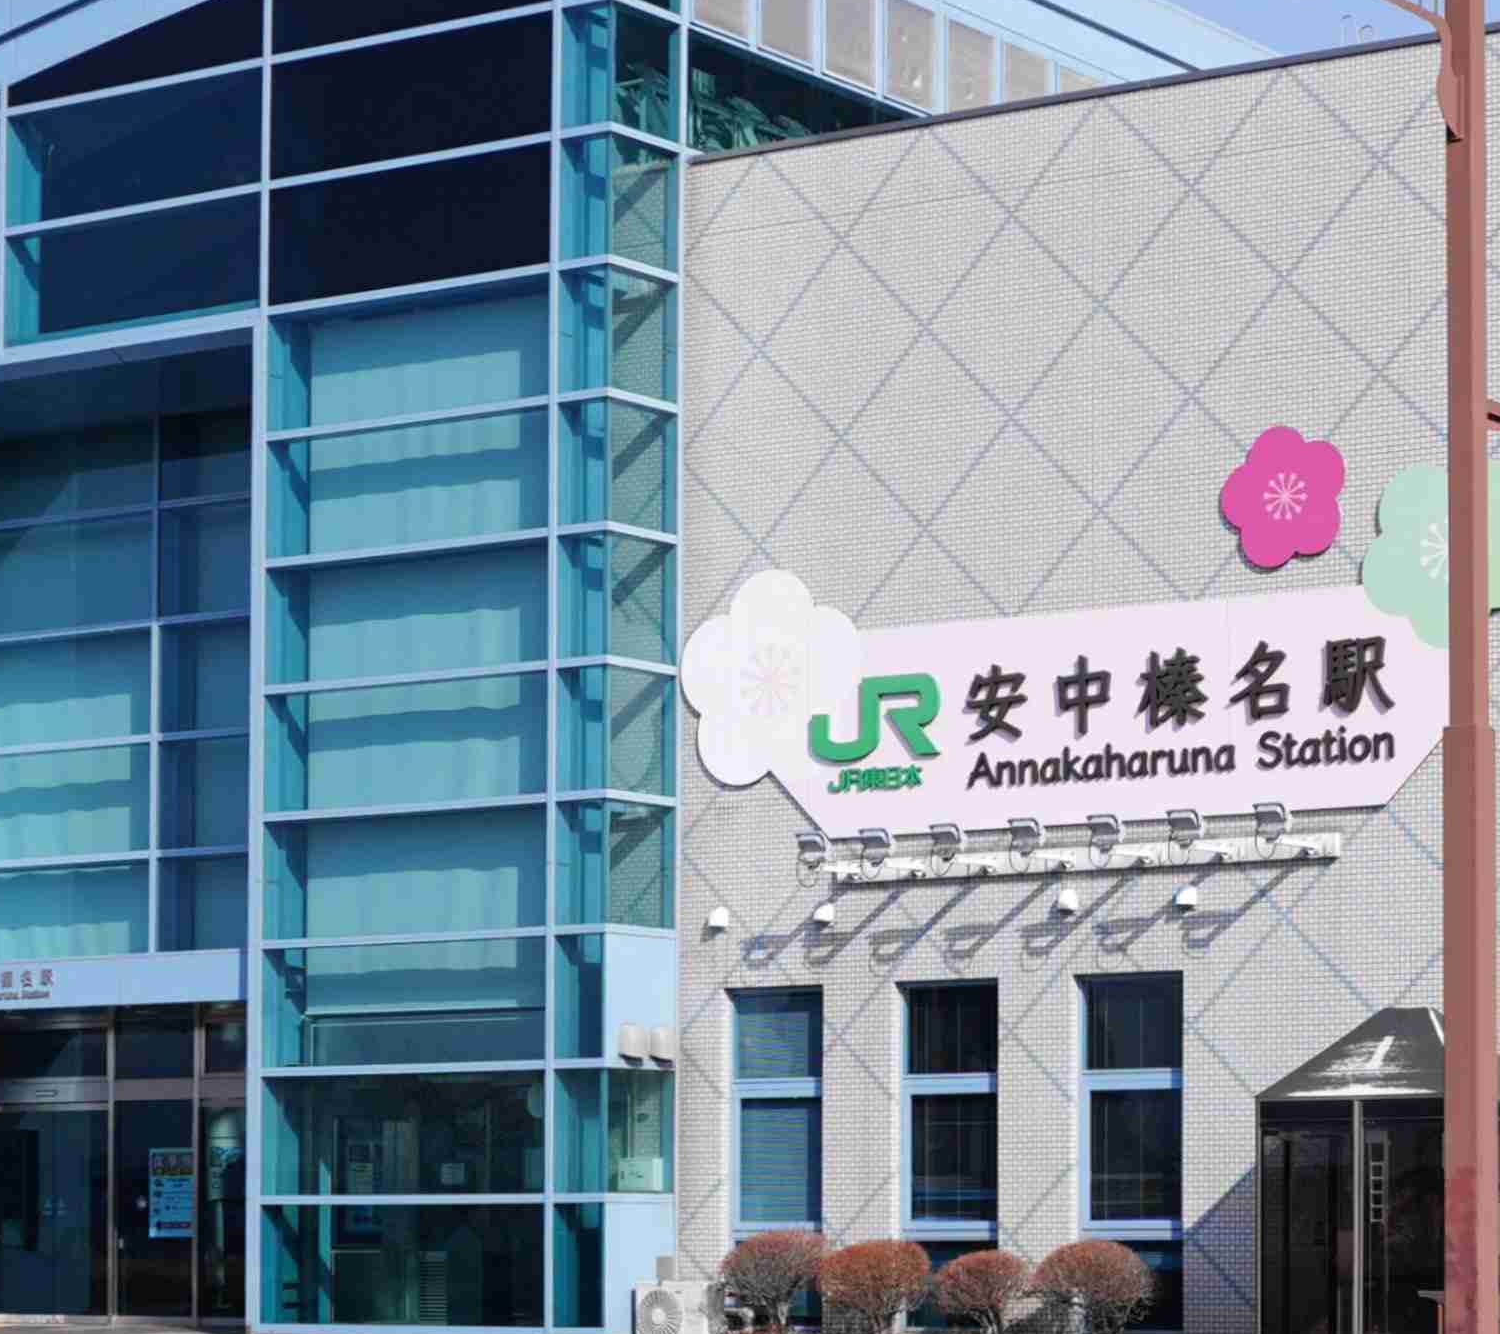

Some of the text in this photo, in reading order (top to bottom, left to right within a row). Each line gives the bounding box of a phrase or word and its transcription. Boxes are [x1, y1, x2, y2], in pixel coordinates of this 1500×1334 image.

[807, 672, 942, 763] JR
[964, 635, 1396, 742] 安中榛名駅
[826, 764, 923, 793] JR東日本
[966, 726, 1395, 789] Annakaharuna Station
